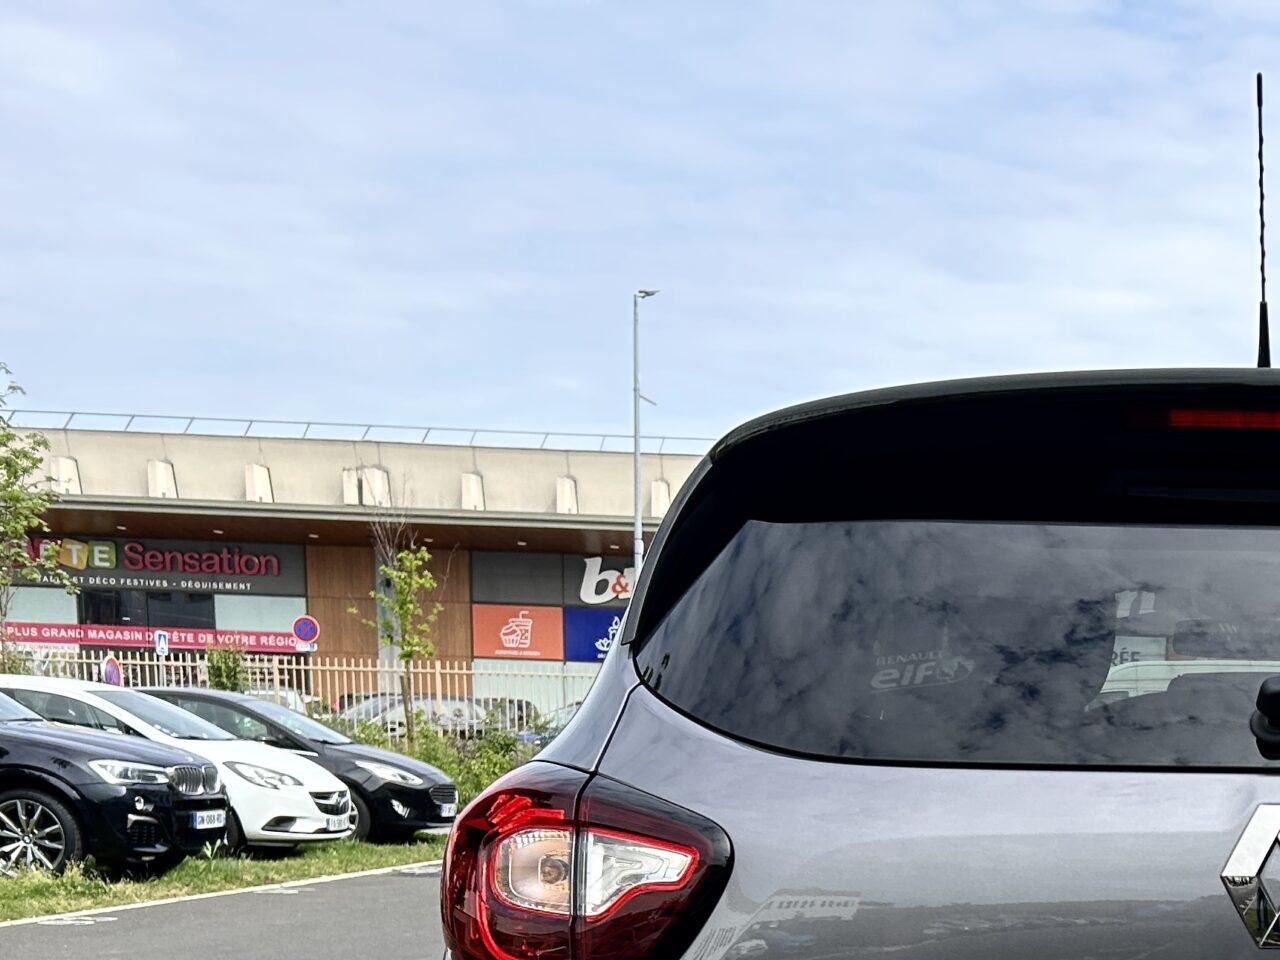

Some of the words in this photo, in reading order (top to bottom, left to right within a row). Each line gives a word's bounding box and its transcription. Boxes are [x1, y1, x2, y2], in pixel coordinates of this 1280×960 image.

[123, 541, 279, 576] Sensation
[89, 575, 116, 586] DÉCO
[120, 577, 168, 588] FESTIVES
[181, 579, 251, 591] DÉGUISEMENT
[7, 626, 38, 637] PLUS
[41, 627, 84, 639] GRAND
[88, 630, 143, 640] MAGASIN
[198, 633, 214, 643] DE
[216, 634, 256, 646] VOTRE
[260, 634, 300, 648] RÉGIO
[875, 650, 943, 666] RENAULT
